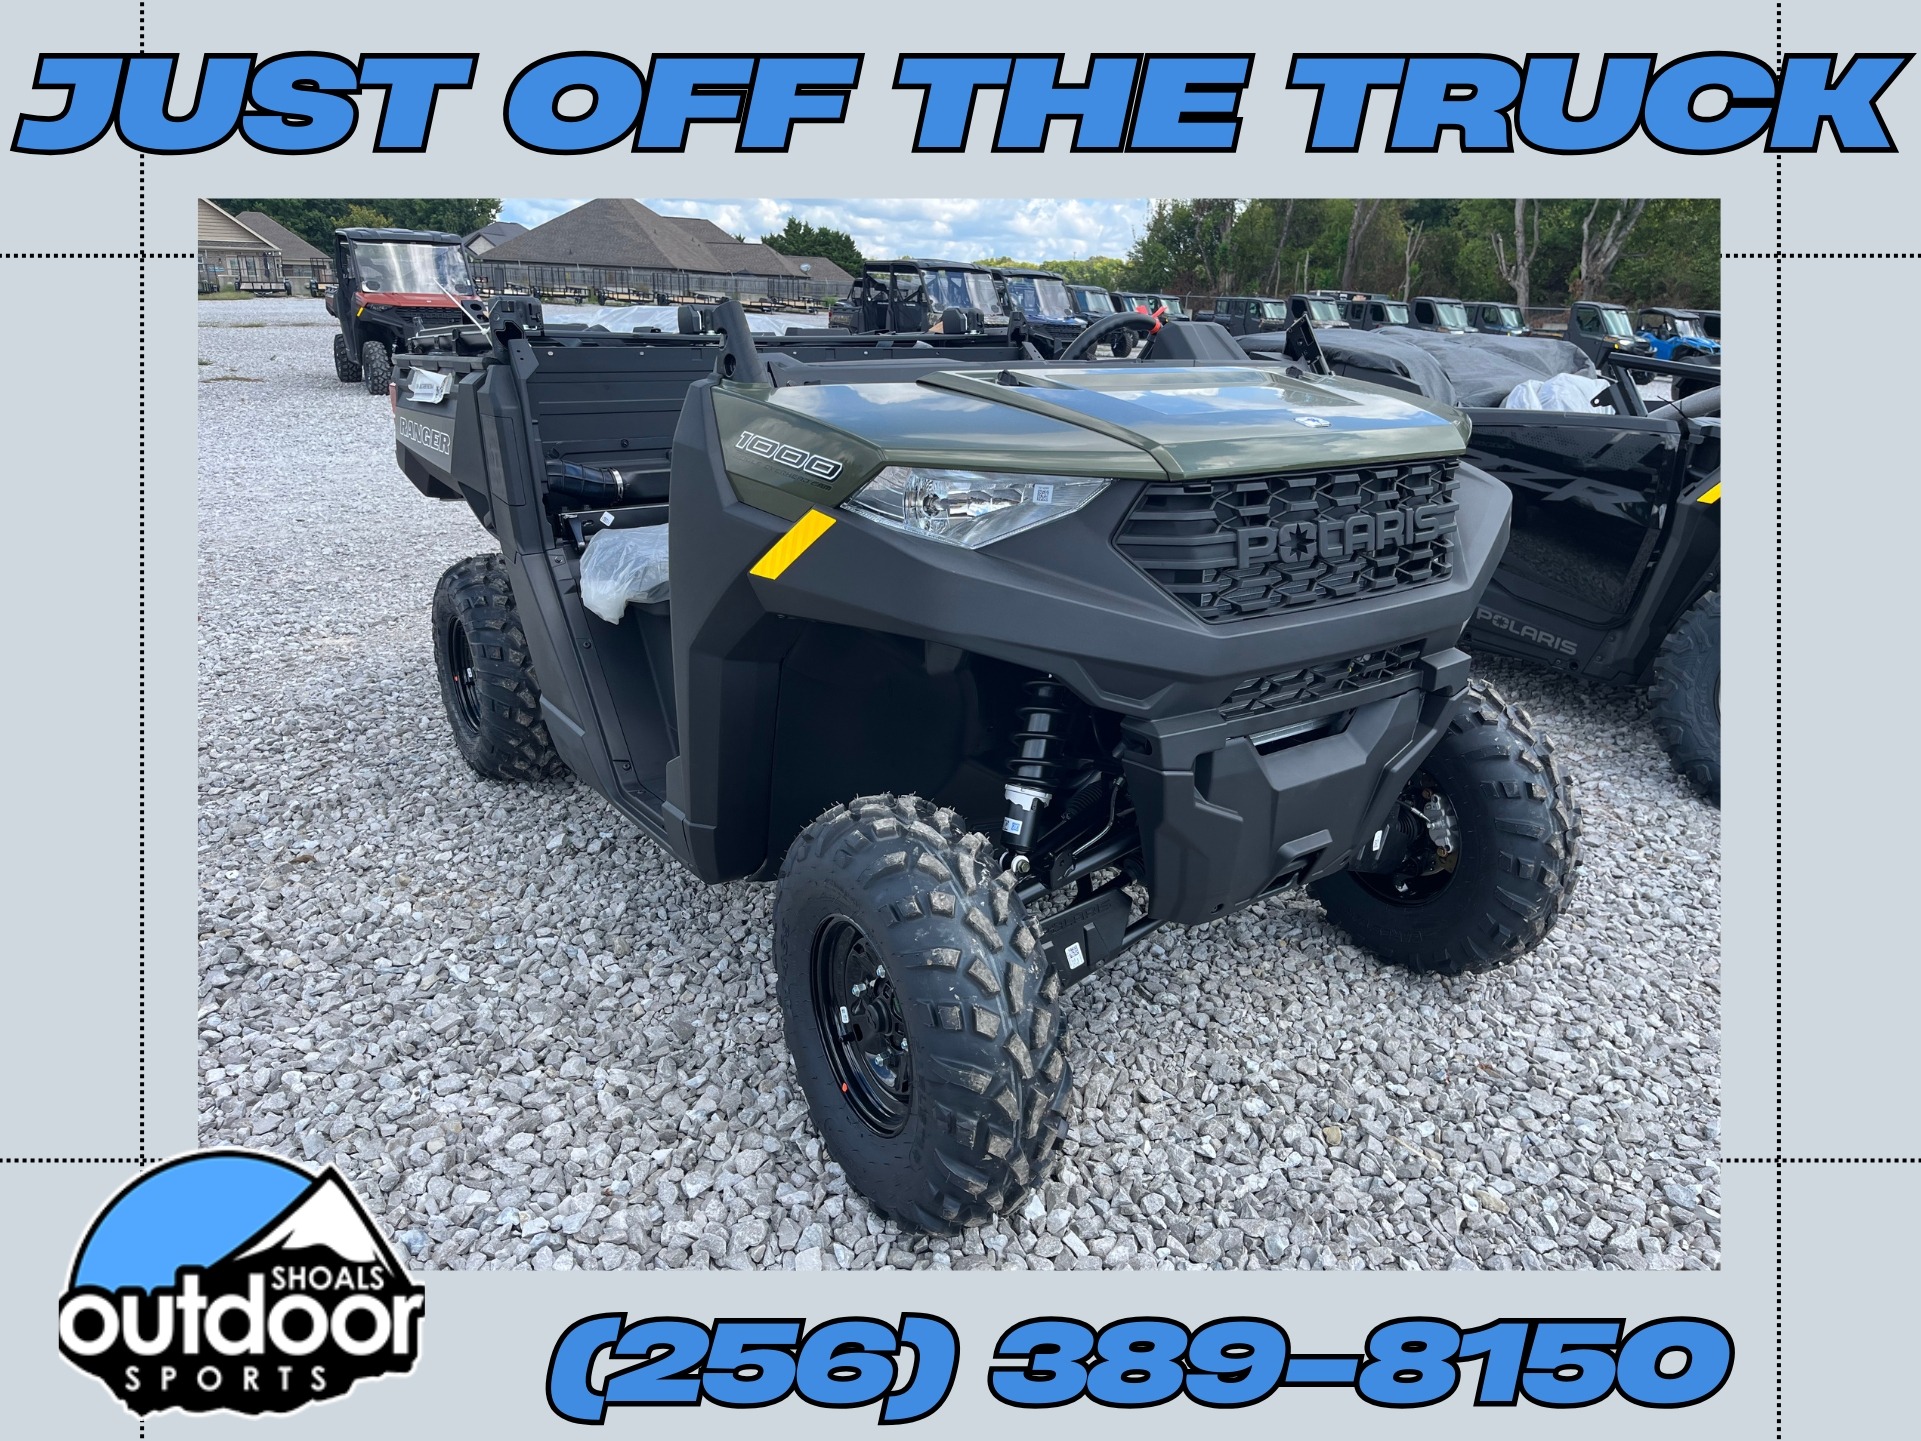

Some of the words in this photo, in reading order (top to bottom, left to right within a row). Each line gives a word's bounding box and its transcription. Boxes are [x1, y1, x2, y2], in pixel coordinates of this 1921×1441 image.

[400, 416, 450, 454] RANGER
[736, 430, 843, 481] 1000
[1237, 503, 1440, 570] POLARIS
[1476, 606, 1579, 656] POLARIS
